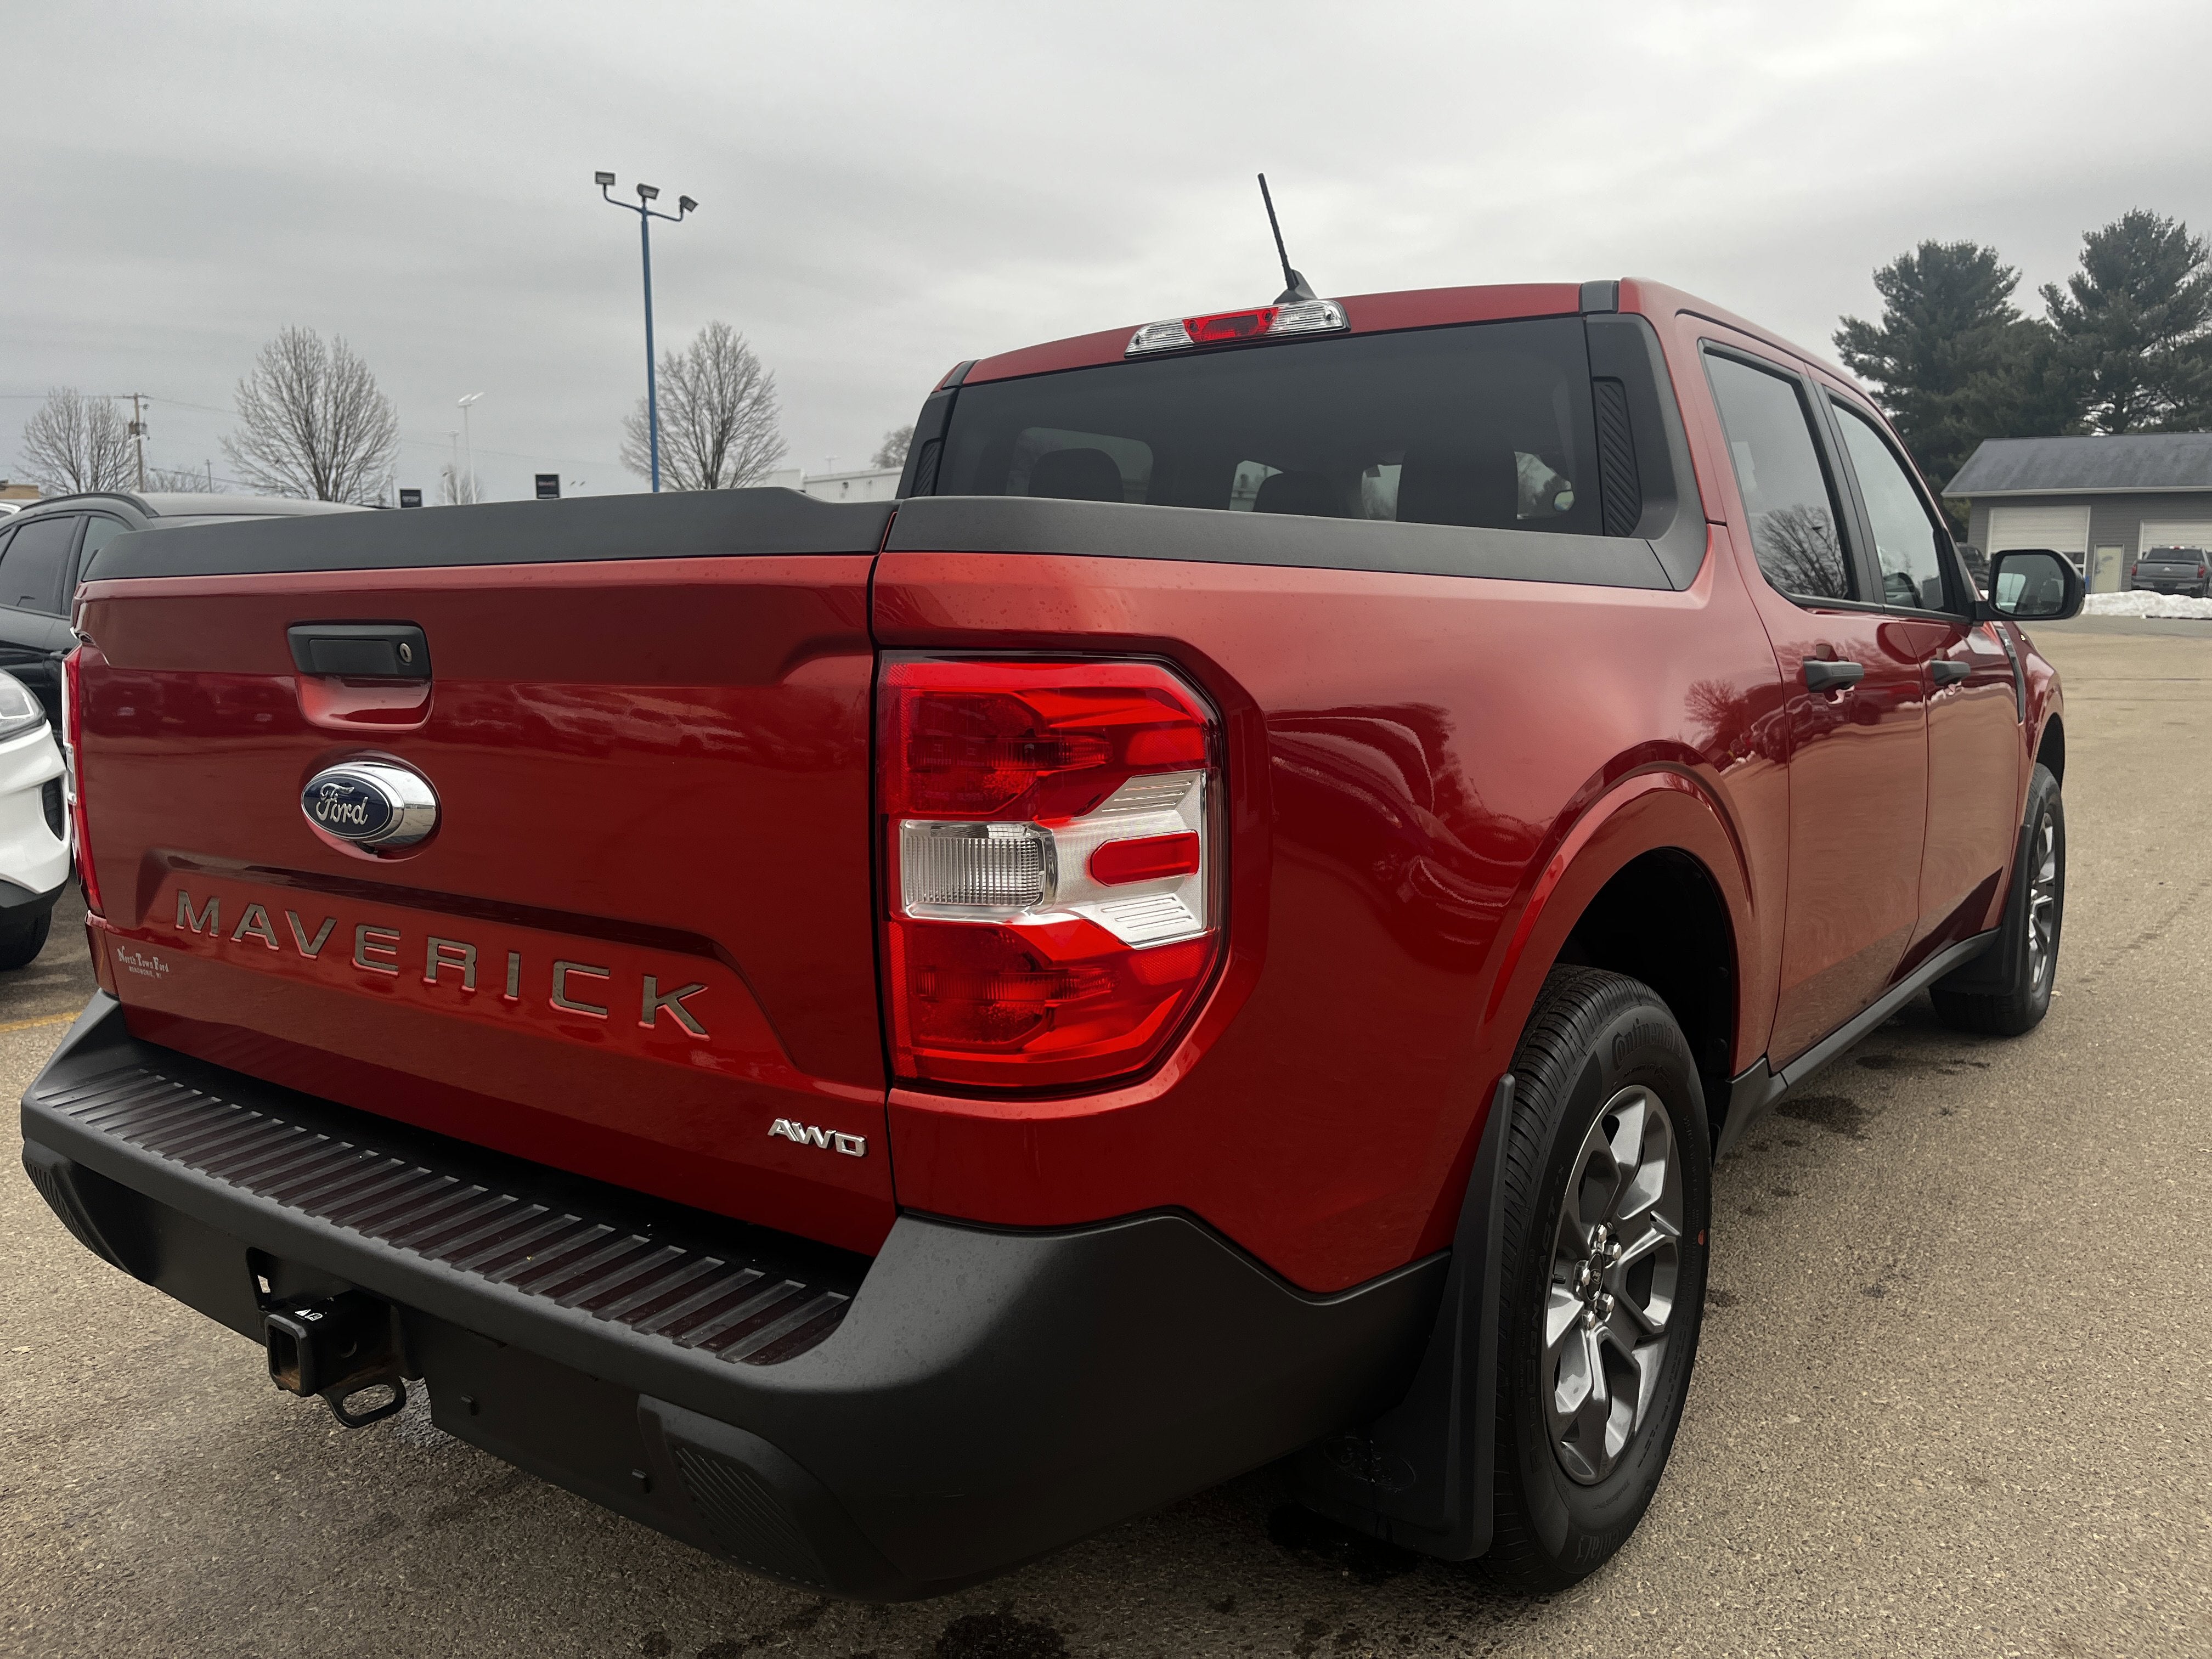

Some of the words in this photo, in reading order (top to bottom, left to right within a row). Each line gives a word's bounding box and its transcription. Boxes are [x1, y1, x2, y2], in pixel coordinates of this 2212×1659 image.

[316, 782, 369, 825] Ford
[174, 890, 709, 1041] MAVERICK
[767, 1117, 868, 1158] AWD
